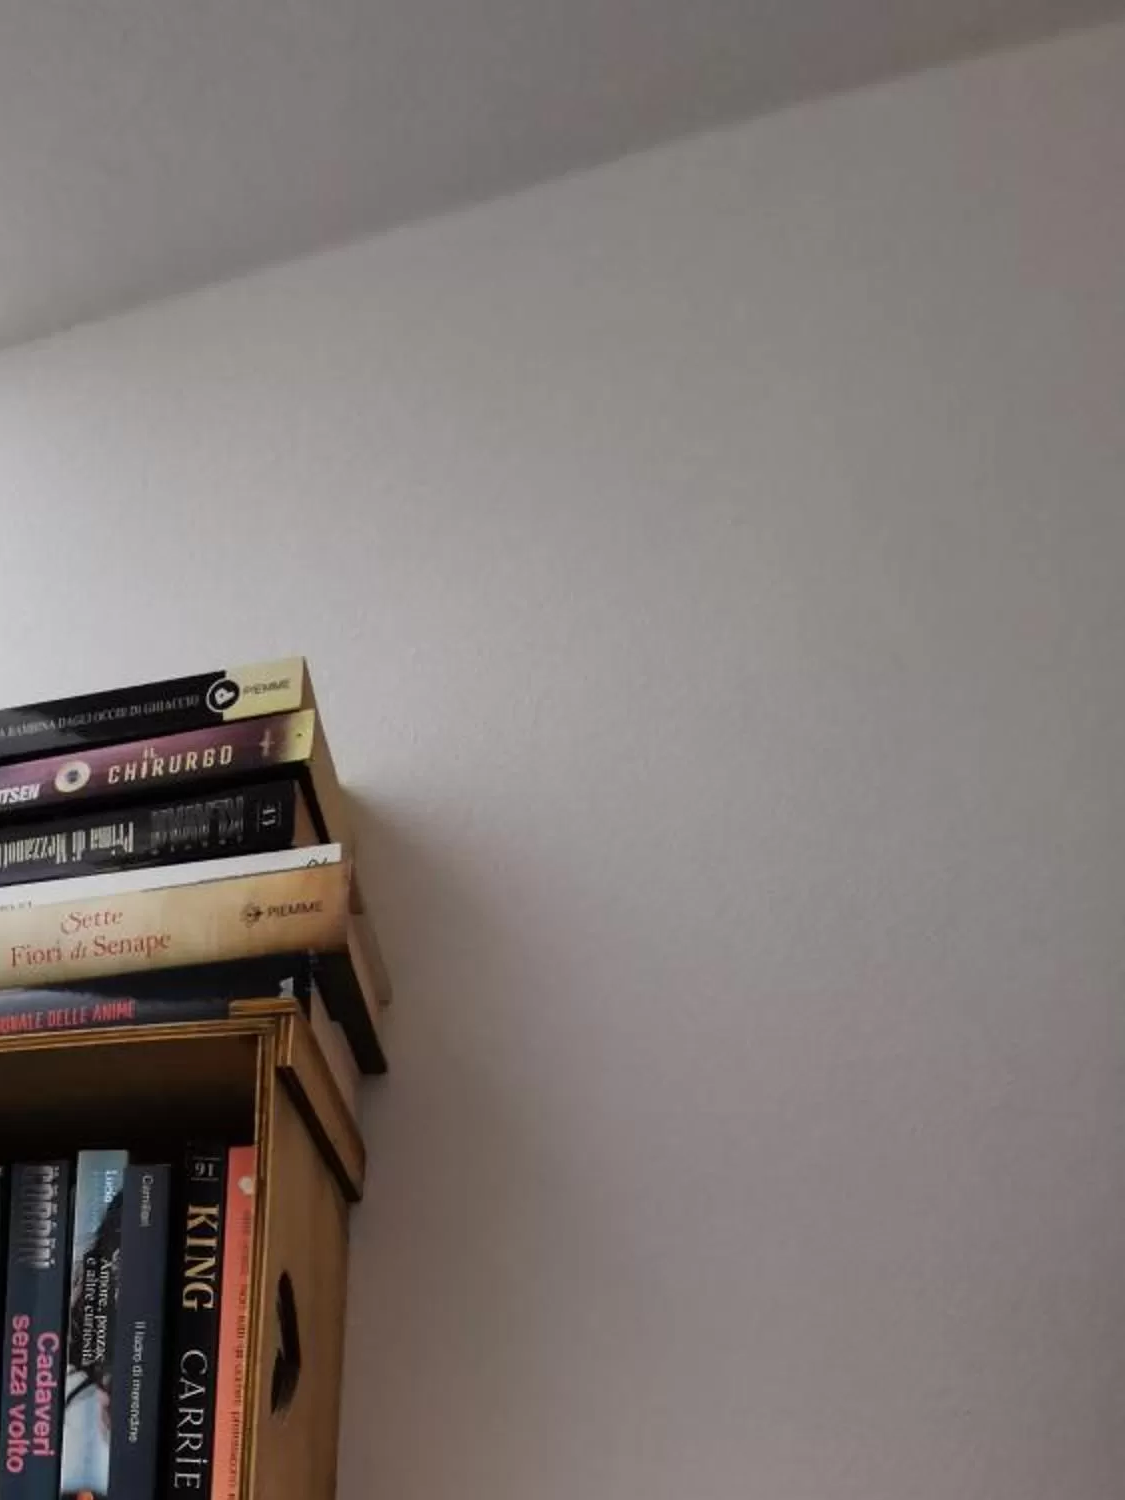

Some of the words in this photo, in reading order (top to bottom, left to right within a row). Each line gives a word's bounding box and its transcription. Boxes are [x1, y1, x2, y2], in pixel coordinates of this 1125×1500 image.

[108, 744, 234, 784] CHIRURGO
[71, 832, 88, 853] di
[91, 822, 135, 854] Prima
[60, 908, 124, 936] Sette
[266, 900, 325, 920] PIEMME
[11, 938, 63, 969] Fiori
[70, 938, 89, 961] di
[92, 932, 173, 966] Senape
[48, 1003, 89, 1030] DELLE
[183, 1203, 220, 1312] KING
[83, 1266, 96, 1302] altre
[97, 1257, 112, 1311] Amore,
[8, 1314, 32, 1396] senza
[94, 1314, 110, 1363] prozac
[132, 1332, 146, 1363] ladro
[131, 1365, 144, 1377] di
[32, 1331, 60, 1458] Cadaveri
[6, 1404, 32, 1474] volto
